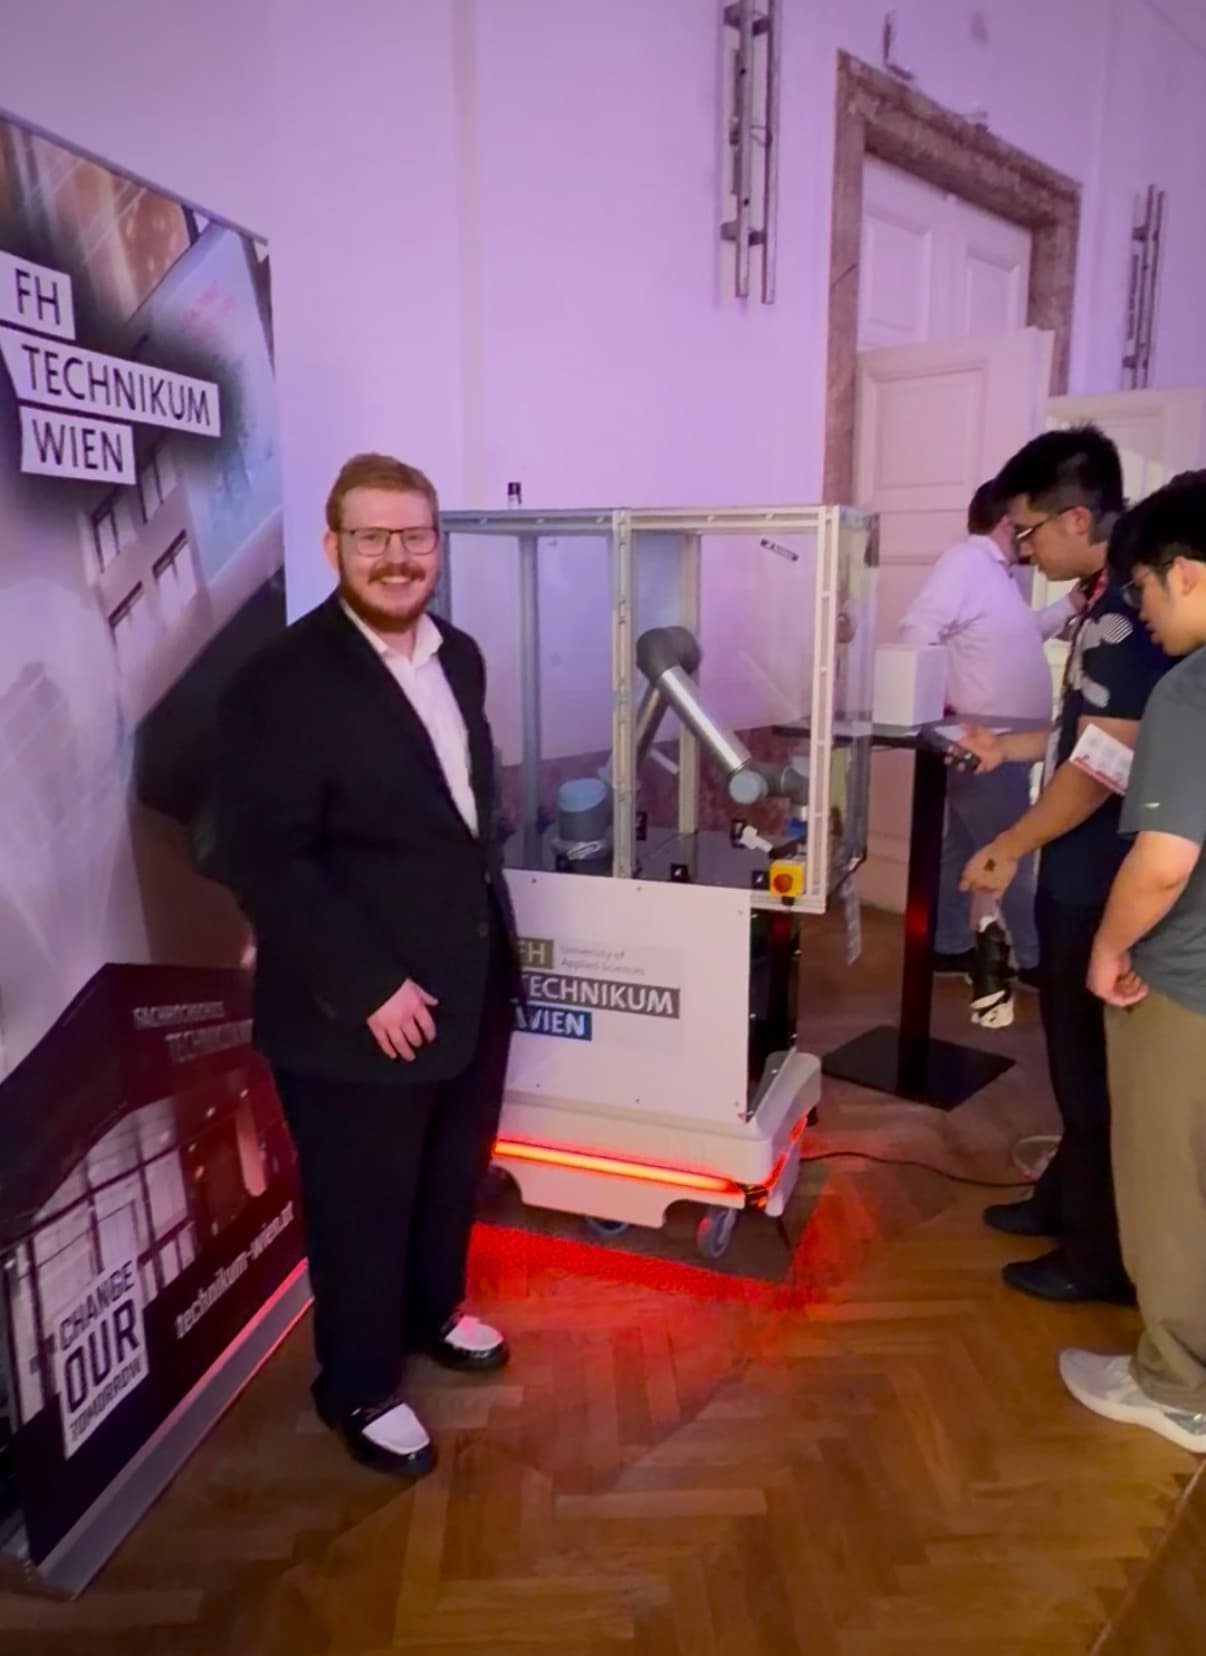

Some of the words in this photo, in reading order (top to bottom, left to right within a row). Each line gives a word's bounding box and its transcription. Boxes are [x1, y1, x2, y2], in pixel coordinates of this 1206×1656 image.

[15, 267, 61, 326] FH
[21, 344, 211, 427] TECHNIKUM
[32, 418, 124, 473] WIEN
[613, 951, 625, 960] of
[59, 1260, 136, 1351] CHANGE
[174, 1200, 295, 1339] technikum-wien.at
[64, 1299, 140, 1414] OUR
[70, 1357, 142, 1442] TOMORROW
